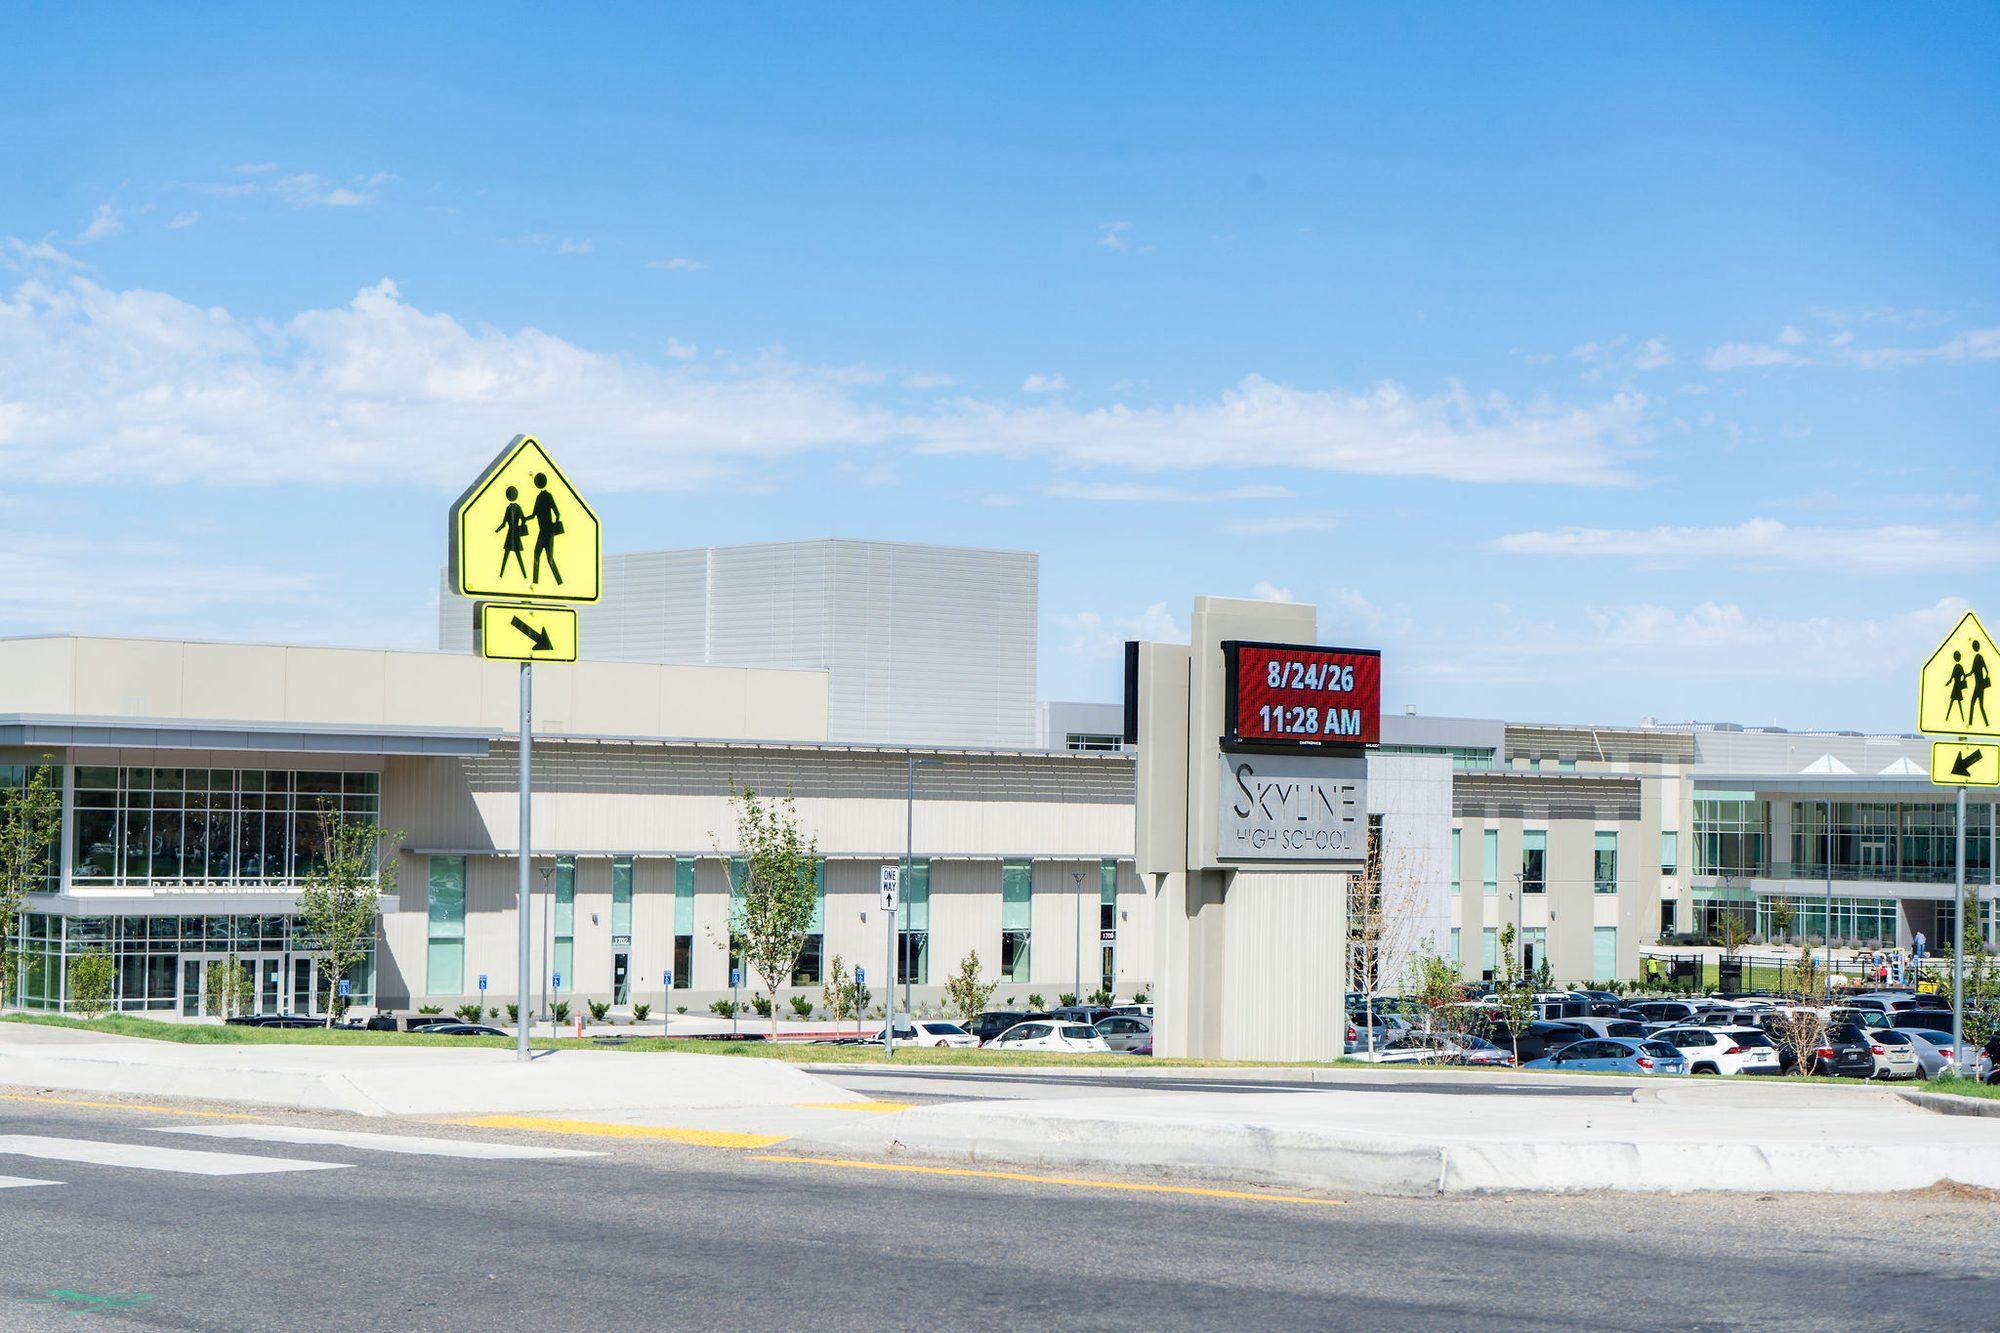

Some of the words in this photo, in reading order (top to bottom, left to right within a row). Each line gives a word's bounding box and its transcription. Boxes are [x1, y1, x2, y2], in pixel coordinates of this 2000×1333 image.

[1267, 661, 1354, 692] 8/24/26
[1259, 704, 1319, 734] 11:28
[1323, 708, 1361, 736] AM
[1236, 829, 1277, 849] HIGH
[1282, 829, 1351, 850] SCHOOL
[883, 870, 897, 881] ONE
[152, 881, 288, 894] PERFORMING
[883, 881, 897, 892] WAY
